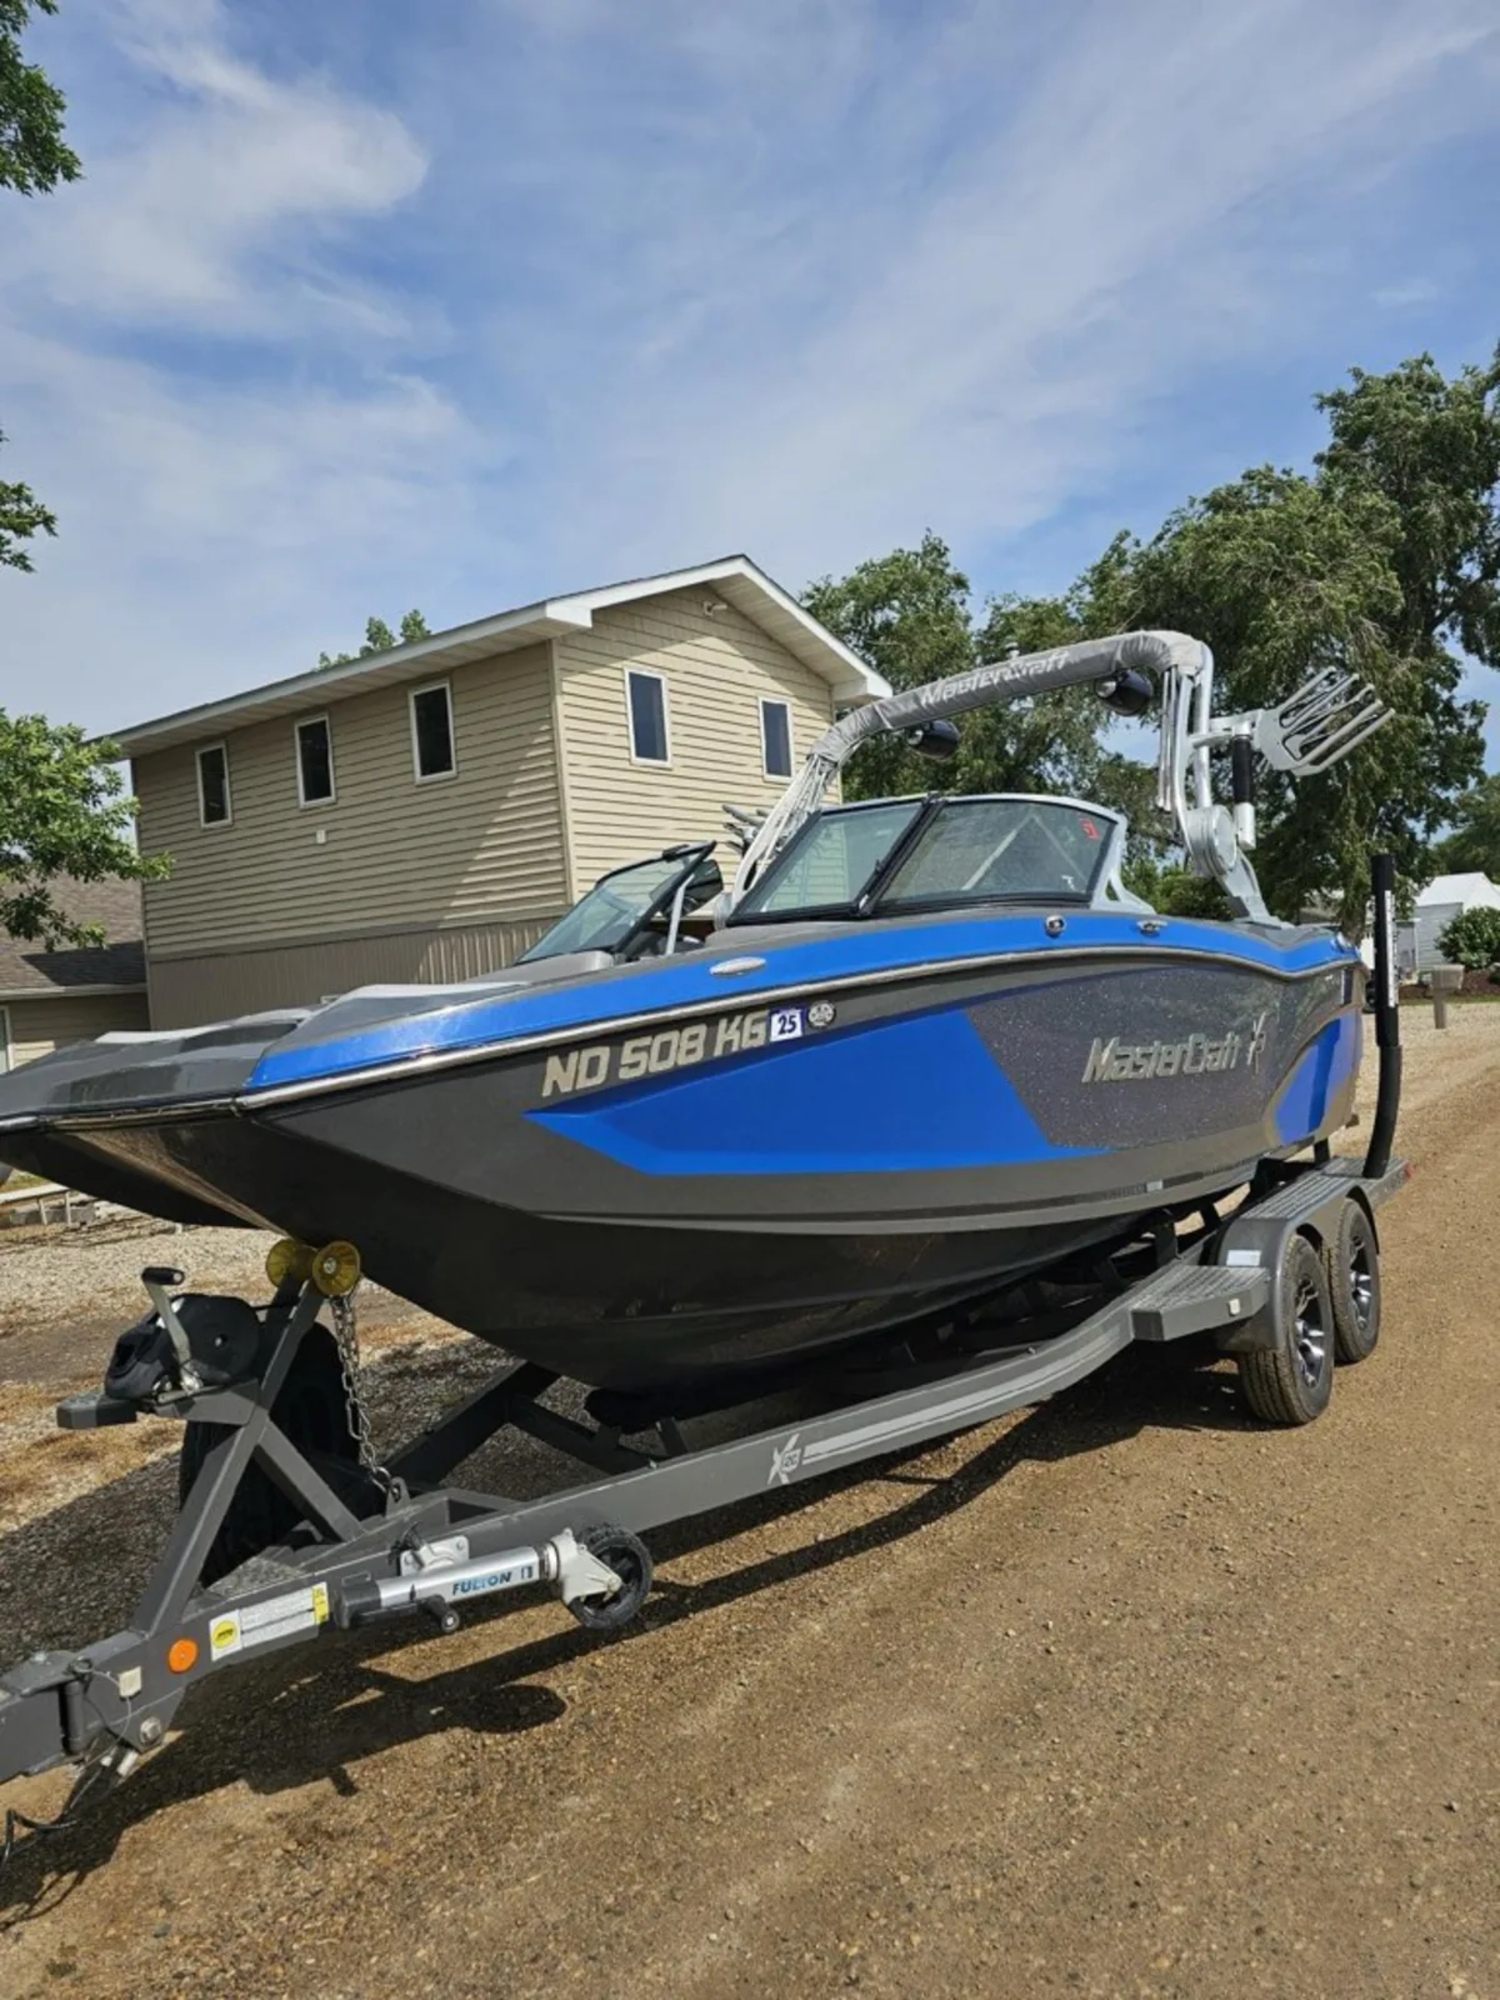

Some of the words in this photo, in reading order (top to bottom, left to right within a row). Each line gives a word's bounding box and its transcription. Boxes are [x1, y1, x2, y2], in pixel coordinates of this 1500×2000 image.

[777, 1014, 798, 1035] 25
[541, 1046, 610, 1097] ND
[619, 1025, 706, 1079] 508
[714, 1010, 770, 1056] KG
[1081, 1031, 1241, 1083] MasterCraft
[452, 1571, 512, 1596] FULTON
